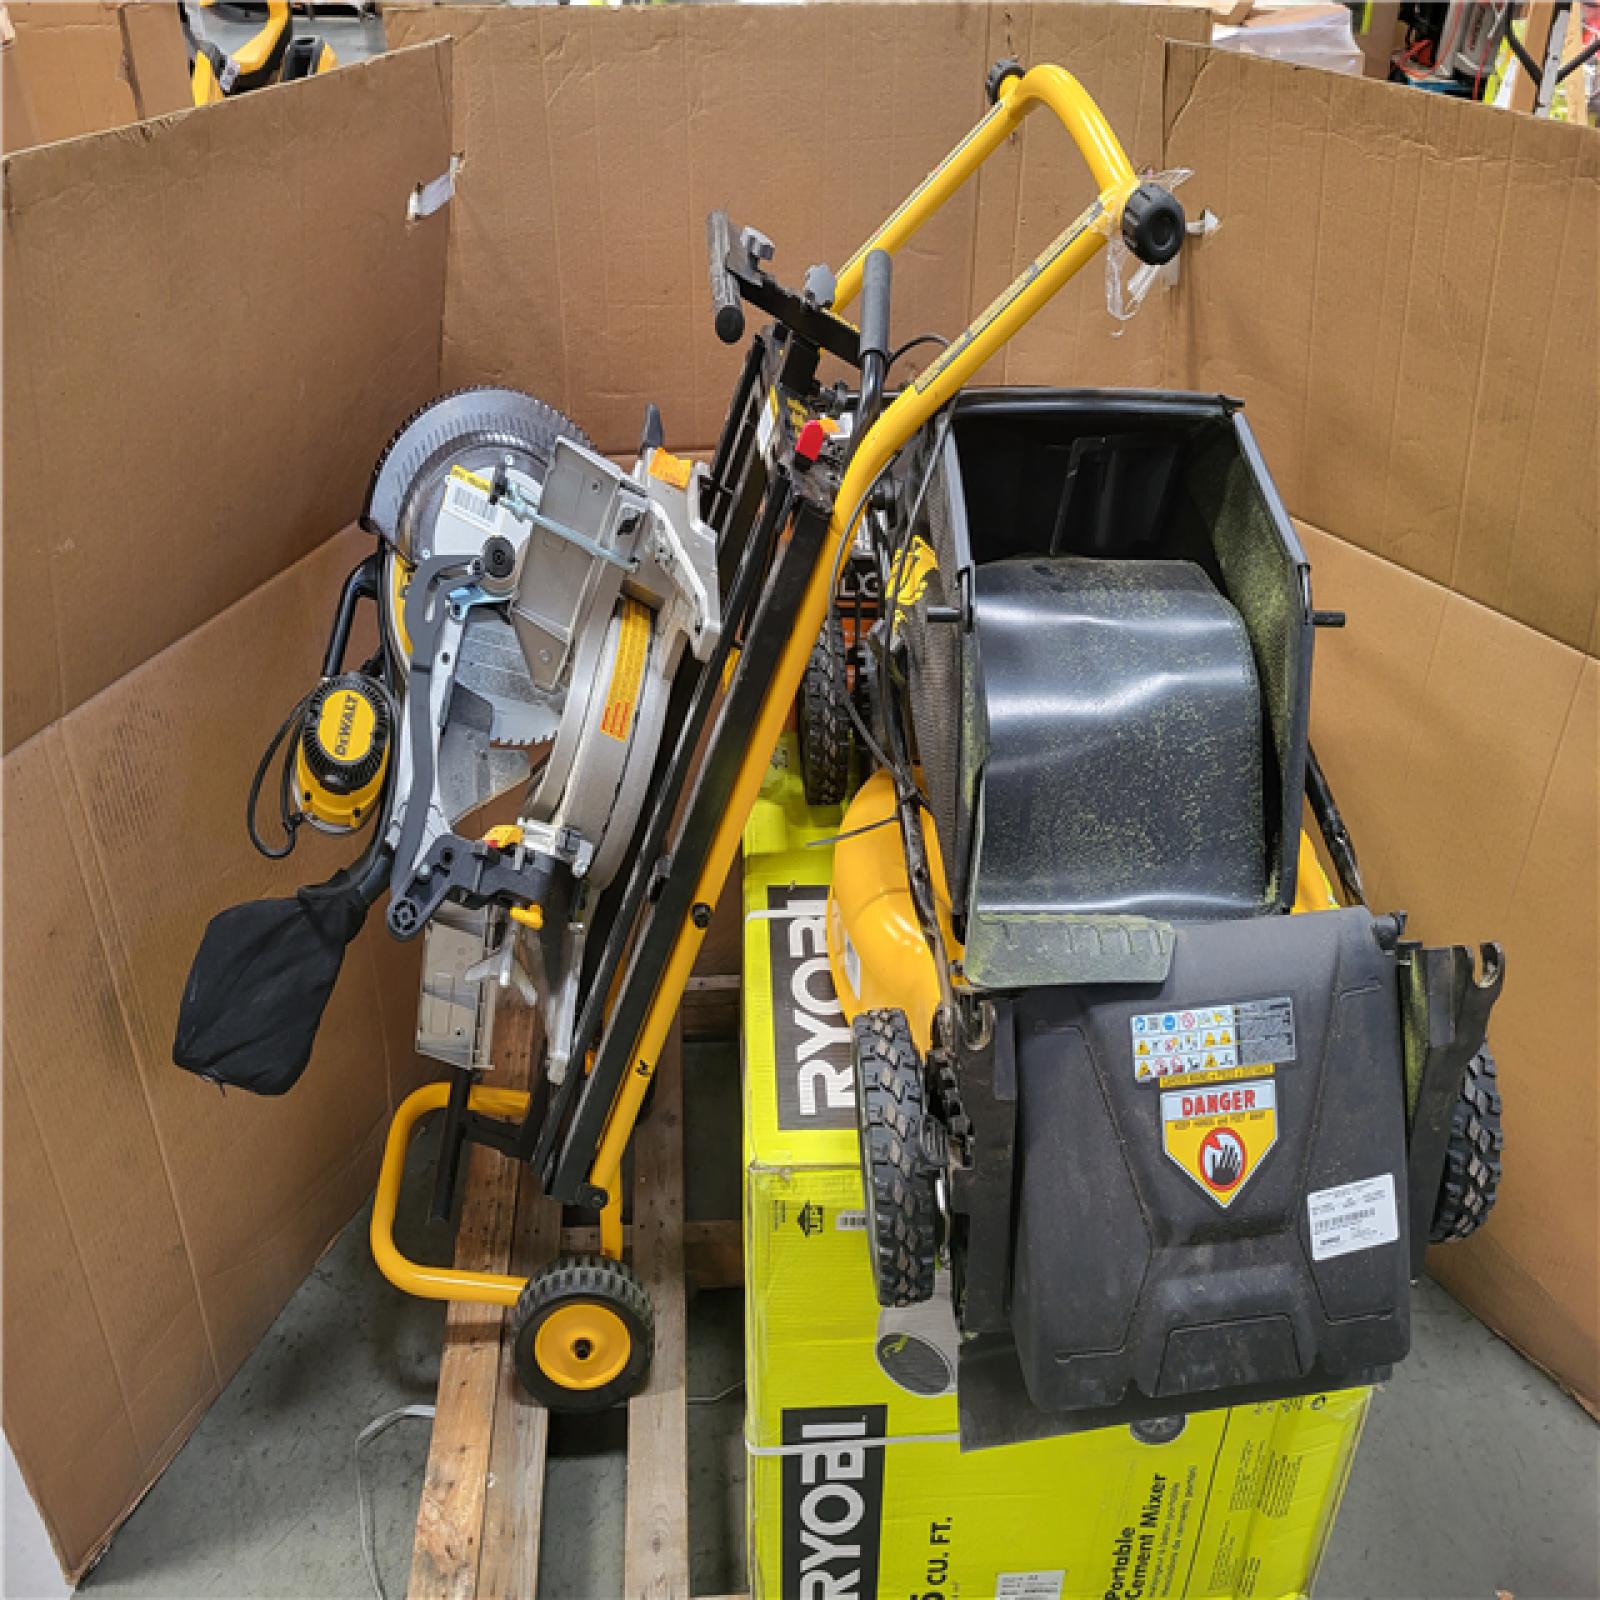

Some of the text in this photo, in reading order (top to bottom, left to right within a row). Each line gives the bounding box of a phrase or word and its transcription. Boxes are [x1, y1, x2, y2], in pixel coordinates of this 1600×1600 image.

[1181, 1089, 1256, 1116] DANGER
[799, 1421, 866, 1600] RYOBI
[929, 1516, 953, 1546] FT.
[1125, 1472, 1168, 1600] Cement Mixer
[926, 1552, 949, 1586] CU.
[1105, 1526, 1136, 1600] Portable
